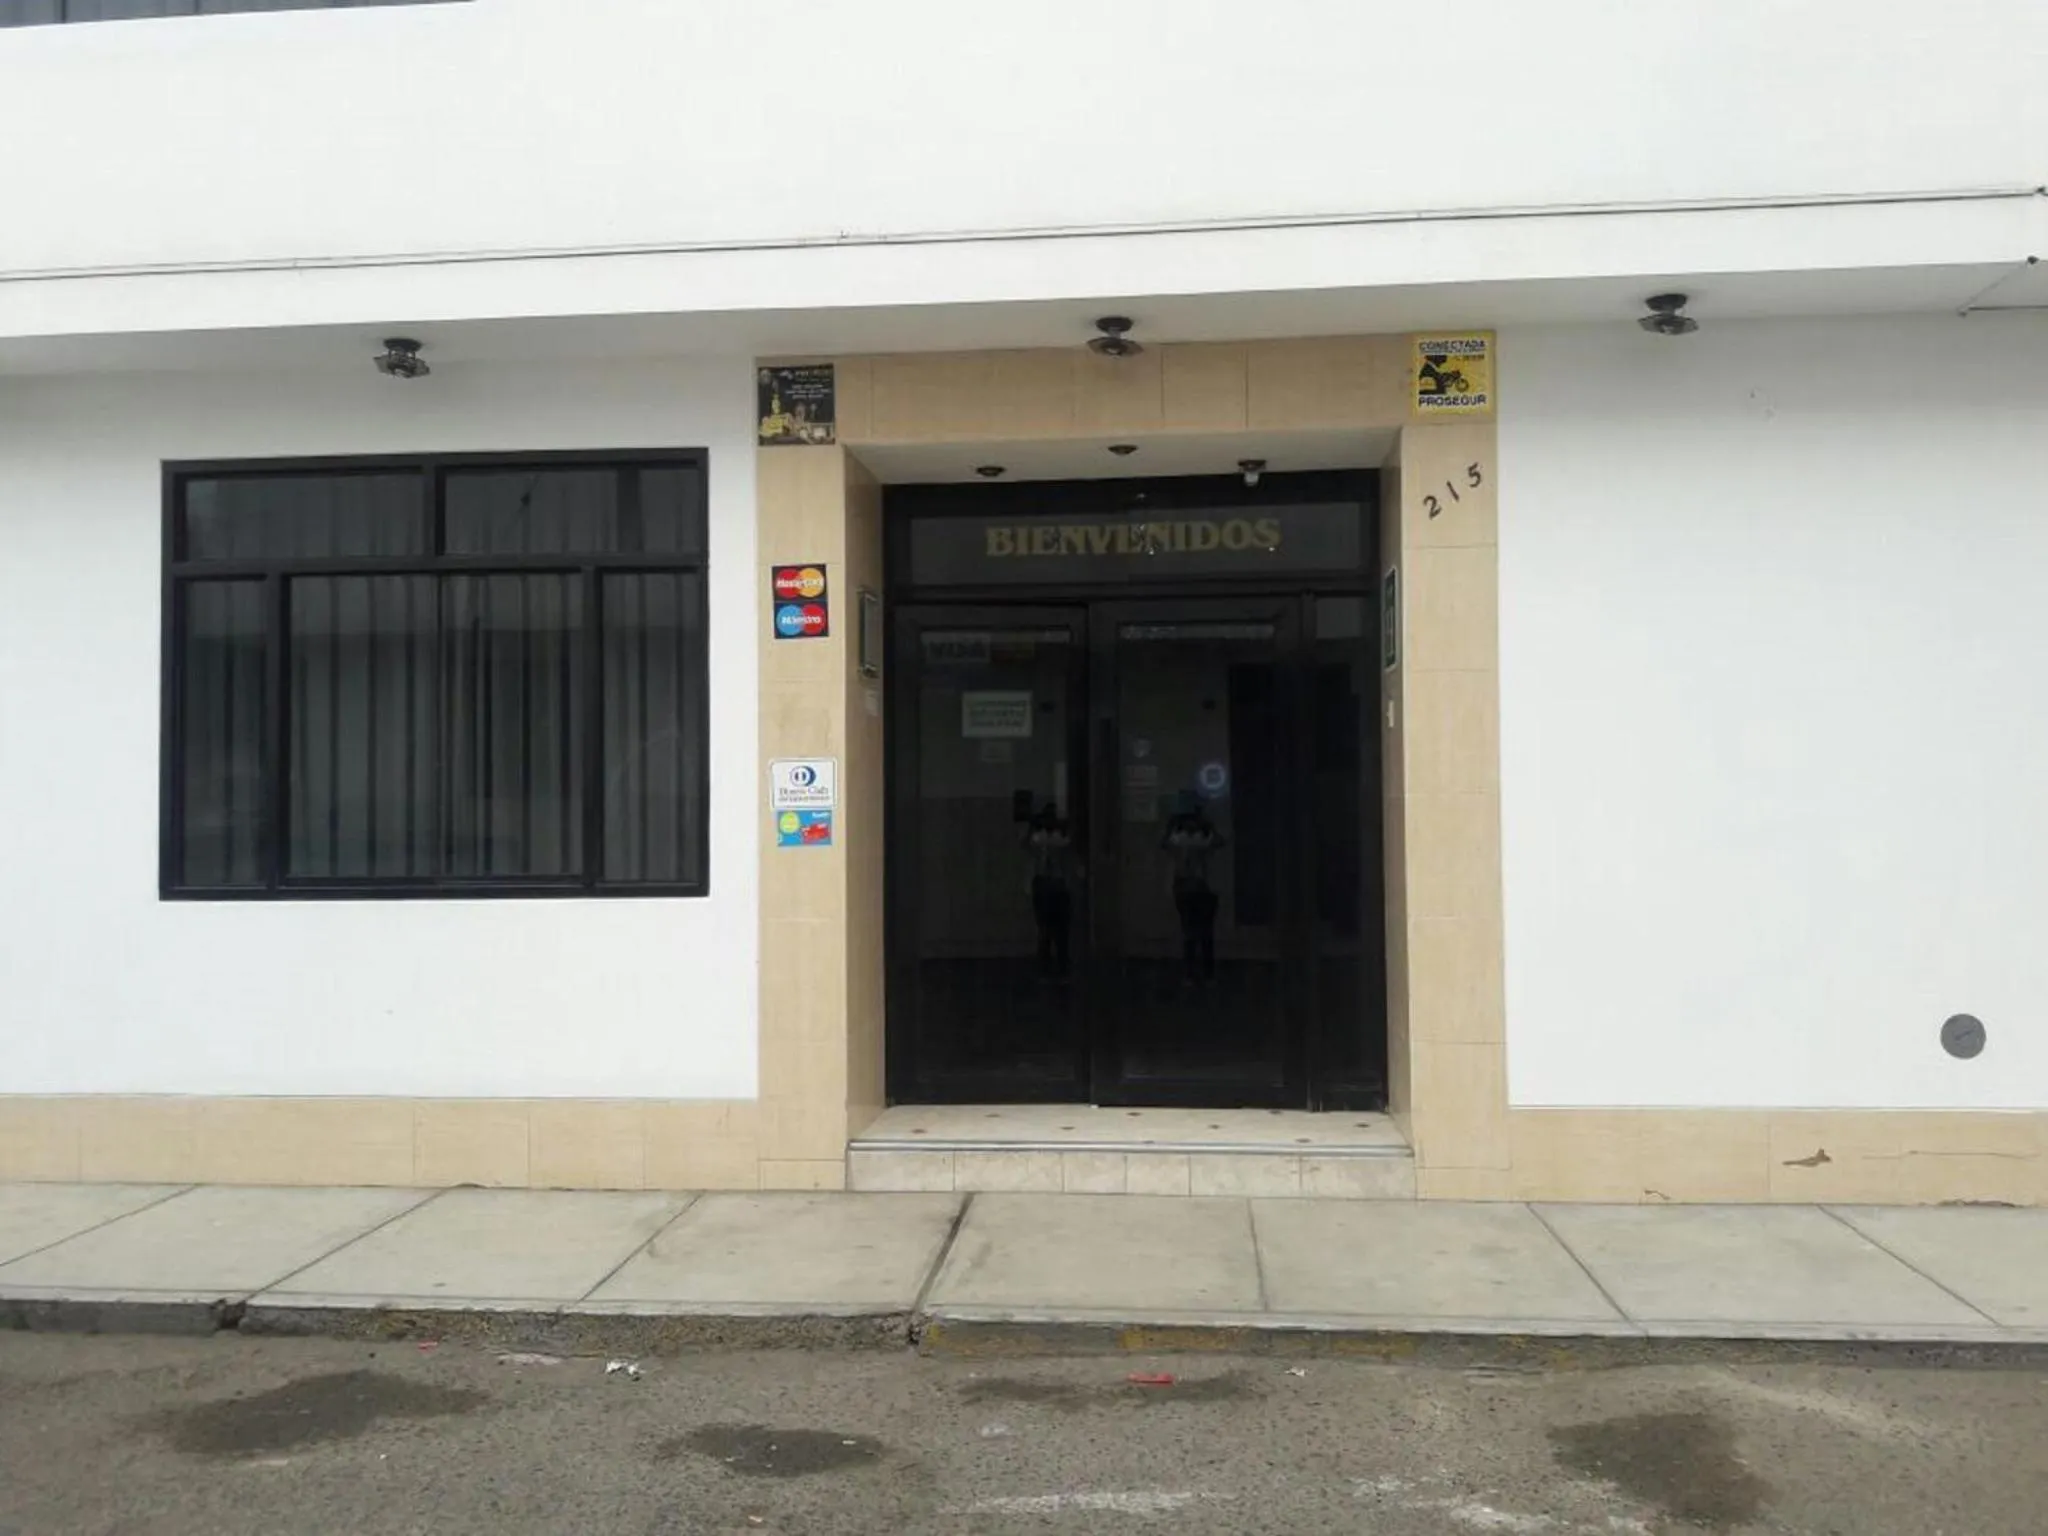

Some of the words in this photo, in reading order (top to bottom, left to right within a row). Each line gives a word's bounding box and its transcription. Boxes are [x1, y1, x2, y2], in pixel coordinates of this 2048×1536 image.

[1419, 340, 1486, 352] CONECTADA
[1418, 394, 1487, 407] PROSEGUR
[1423, 462, 1482, 520] 215
[984, 518, 1282, 556] BIENVENIDOS
